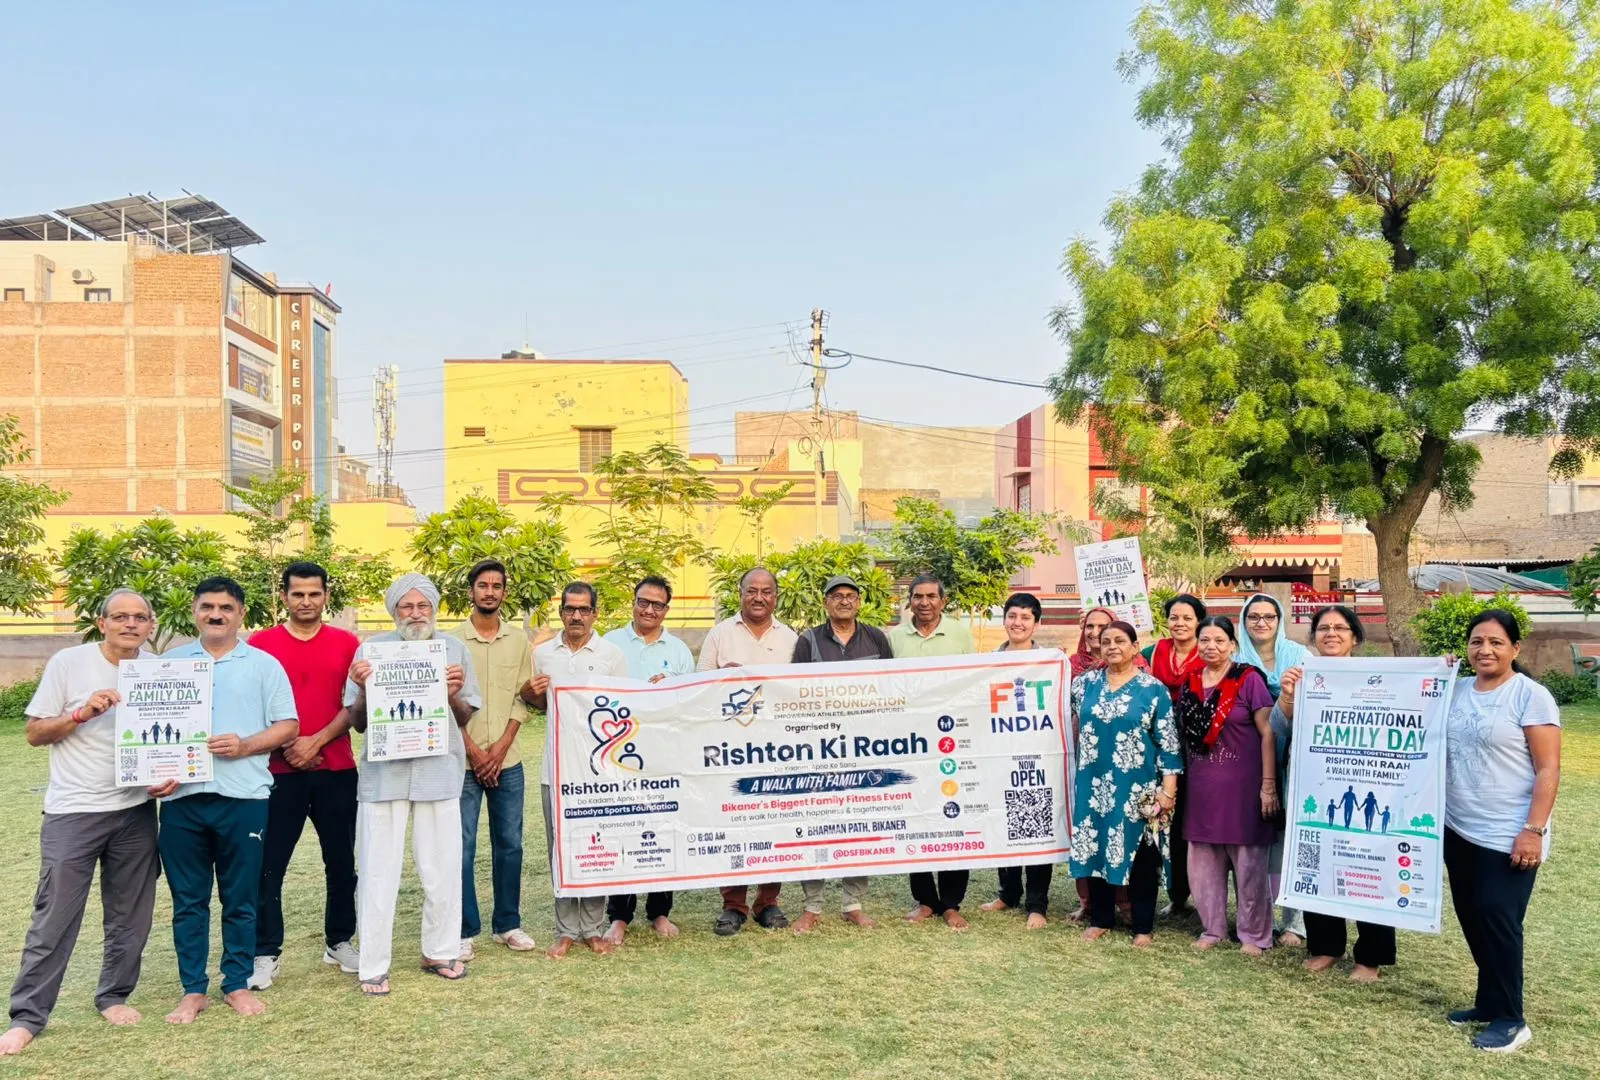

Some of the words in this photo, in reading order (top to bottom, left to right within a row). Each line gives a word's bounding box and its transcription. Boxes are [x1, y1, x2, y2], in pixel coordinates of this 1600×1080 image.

[291, 302, 301, 406] CAREER
[1084, 564, 1114, 577] FAMILY
[1116, 561, 1133, 572] DAY
[1086, 556, 1129, 568] INTERNATIONAL
[378, 661, 433, 671] INTERNATIONAL
[375, 670, 413, 682] FAMILY
[417, 668, 437, 680] DAY
[134, 681, 196, 691] INTERNATIONAL
[800, 684, 877, 698] DISHODYA
[129, 690, 173, 702] FAMILY
[177, 689, 200, 701] DAY
[1421, 690, 1442, 698] INDI
[774, 701, 821, 712] SPORTS
[825, 697, 906, 709] FOUNDATION
[991, 714, 1054, 733] INDIA
[1320, 710, 1424, 729] INTERNATIONAL
[785, 723, 829, 734] Organised
[830, 722, 841, 732] By
[1313, 724, 1380, 748] FAMILY
[1387, 728, 1427, 752] DAY
[703, 742, 813, 767] Rishton
[820, 734, 846, 759] Ki
[854, 732, 928, 757] Raah
[1363, 750, 1395, 758] TOGETHER
[1018, 760, 1035, 770] NOW
[1326, 756, 1365, 767] RISHTON
[1367, 759, 1378, 768] KI
[1380, 761, 1411, 770] RAAH
[1010, 769, 1045, 788] OPEN
[1331, 767, 1351, 776] WALK
[1352, 768, 1371, 778] WITH
[1372, 770, 1401, 780] FAMILY
[561, 782, 619, 796] Rishton
[623, 778, 637, 791] Ki
[640, 777, 680, 790] Raah
[751, 783, 758, 792] A
[761, 779, 794, 792] WALK
[795, 776, 823, 790] WITH
[825, 772, 866, 788] FAMILY
[722, 801, 769, 812] Bikaner's
[771, 799, 808, 811] Biggest
[811, 797, 844, 807] Family
[846, 794, 882, 803] Fitness
[884, 791, 912, 801] Event
[565, 808, 604, 818] Dishodya
[604, 805, 631, 816] Sports
[632, 802, 678, 812] Foundation
[749, 812, 765, 820] walk
[767, 811, 778, 819] for
[806, 808, 844, 817] happiness
[598, 820, 636, 829] Sponsored
[637, 820, 645, 828] By
[872, 819, 906, 831] BIKANER
[715, 832, 725, 840] AM
[1299, 829, 1320, 843] FREE
[698, 847, 706, 855] 15
[707, 846, 721, 855] MAY
[723, 844, 741, 853] 2026
[749, 841, 773, 851] FRIDAY
[832, 847, 896, 860] @DSFBIKANER
[920, 841, 985, 853] 9602997890
[746, 853, 804, 866] @FACEBOOK
[1294, 881, 1319, 896] OPEN
